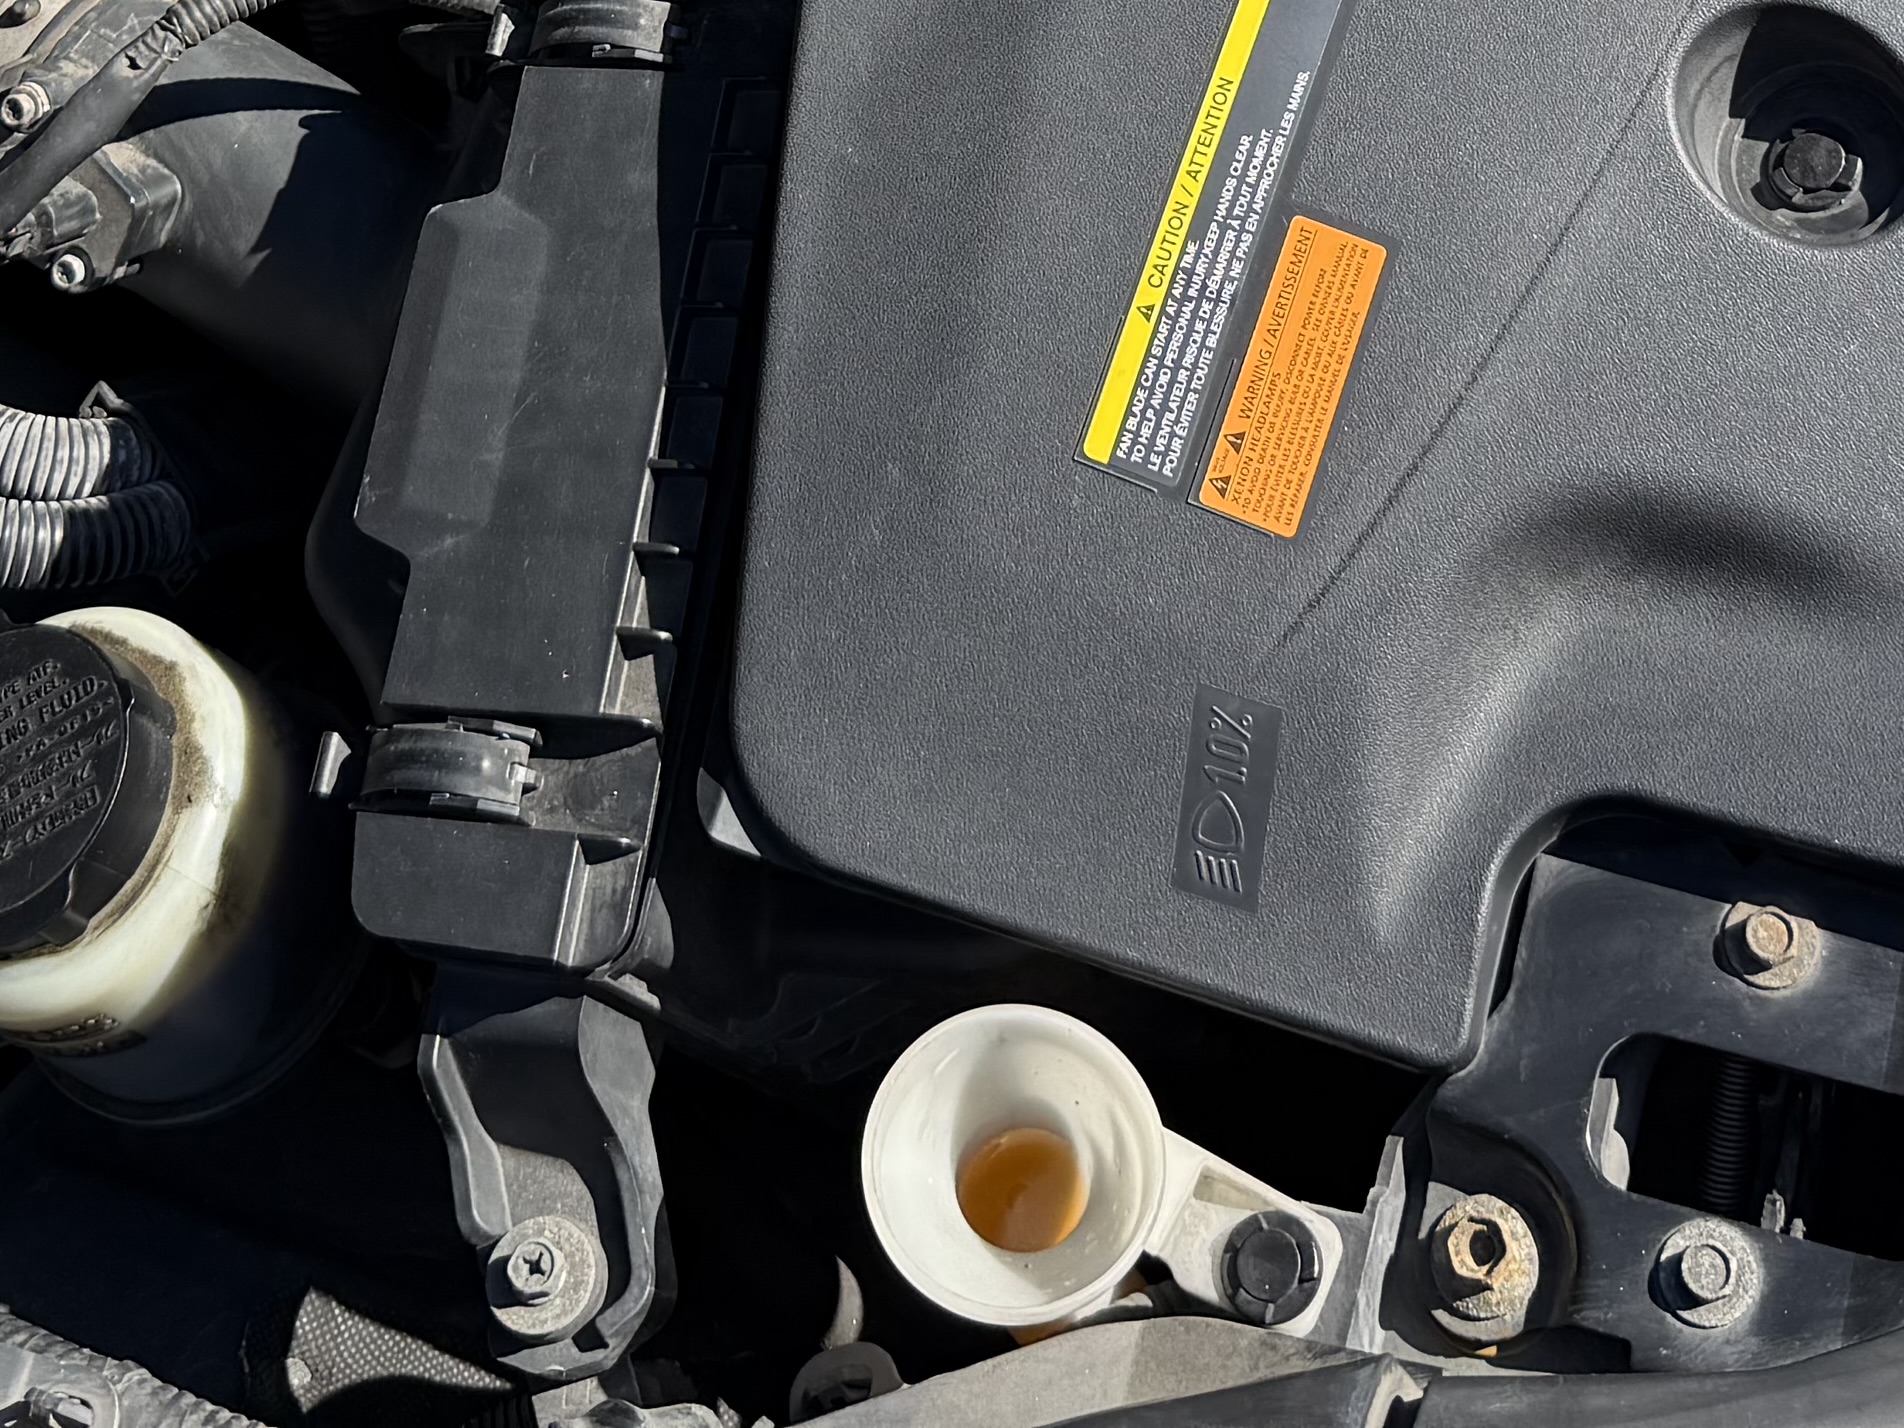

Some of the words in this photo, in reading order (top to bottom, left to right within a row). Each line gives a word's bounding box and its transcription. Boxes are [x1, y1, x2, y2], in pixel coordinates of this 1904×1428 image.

[1286, 67, 1311, 111] MAINS.
[1277, 110, 1297, 136] LES
[1243, 126, 1274, 185] MOMENT.
[1250, 132, 1289, 214] APPROCHER
[1145, 200, 1190, 290] CAUTION
[1182, 75, 1233, 182] ATTENTION
[1212, 175, 1238, 222] HANDS
[1232, 183, 1255, 218] TOUT
[1244, 212, 1262, 232] EN
[1200, 227, 1238, 298] DÉMARRER
[1235, 231, 1255, 258] PAS
[1169, 269, 1189, 298] ANY
[1228, 257, 1246, 278] NE
[1163, 297, 1180, 316] AT
[1197, 298, 1215, 319] DE
[1236, 347, 1273, 421] WARNING
[1264, 225, 1315, 339] AVERTISSEMENT
[1149, 315, 1173, 357] START
[1162, 297, 1196, 367] PERSONAL
[1180, 318, 1208, 369] RISQUE
[1138, 356, 1159, 387] CAN
[1148, 365, 1173, 409] AVOID
[1189, 347, 1215, 392] TOUTE
[1123, 386, 1149, 431] BLADE
[1136, 407, 1159, 444] HELP
[1151, 366, 1191, 452] VENTILATEUR
[1171, 389, 1200, 437] ÉVITER
[1114, 430, 1134, 459] FAN
[1129, 442, 1146, 464] TO
[1160, 436, 1185, 477] POUR
[1228, 454, 1254, 504] XENON
[1246, 370, 1283, 453] HEADLAMPS
[1145, 451, 1162, 471] LE
[15, 670, 70, 712] LEVEL.
[34, 669, 109, 724] FLUID.
